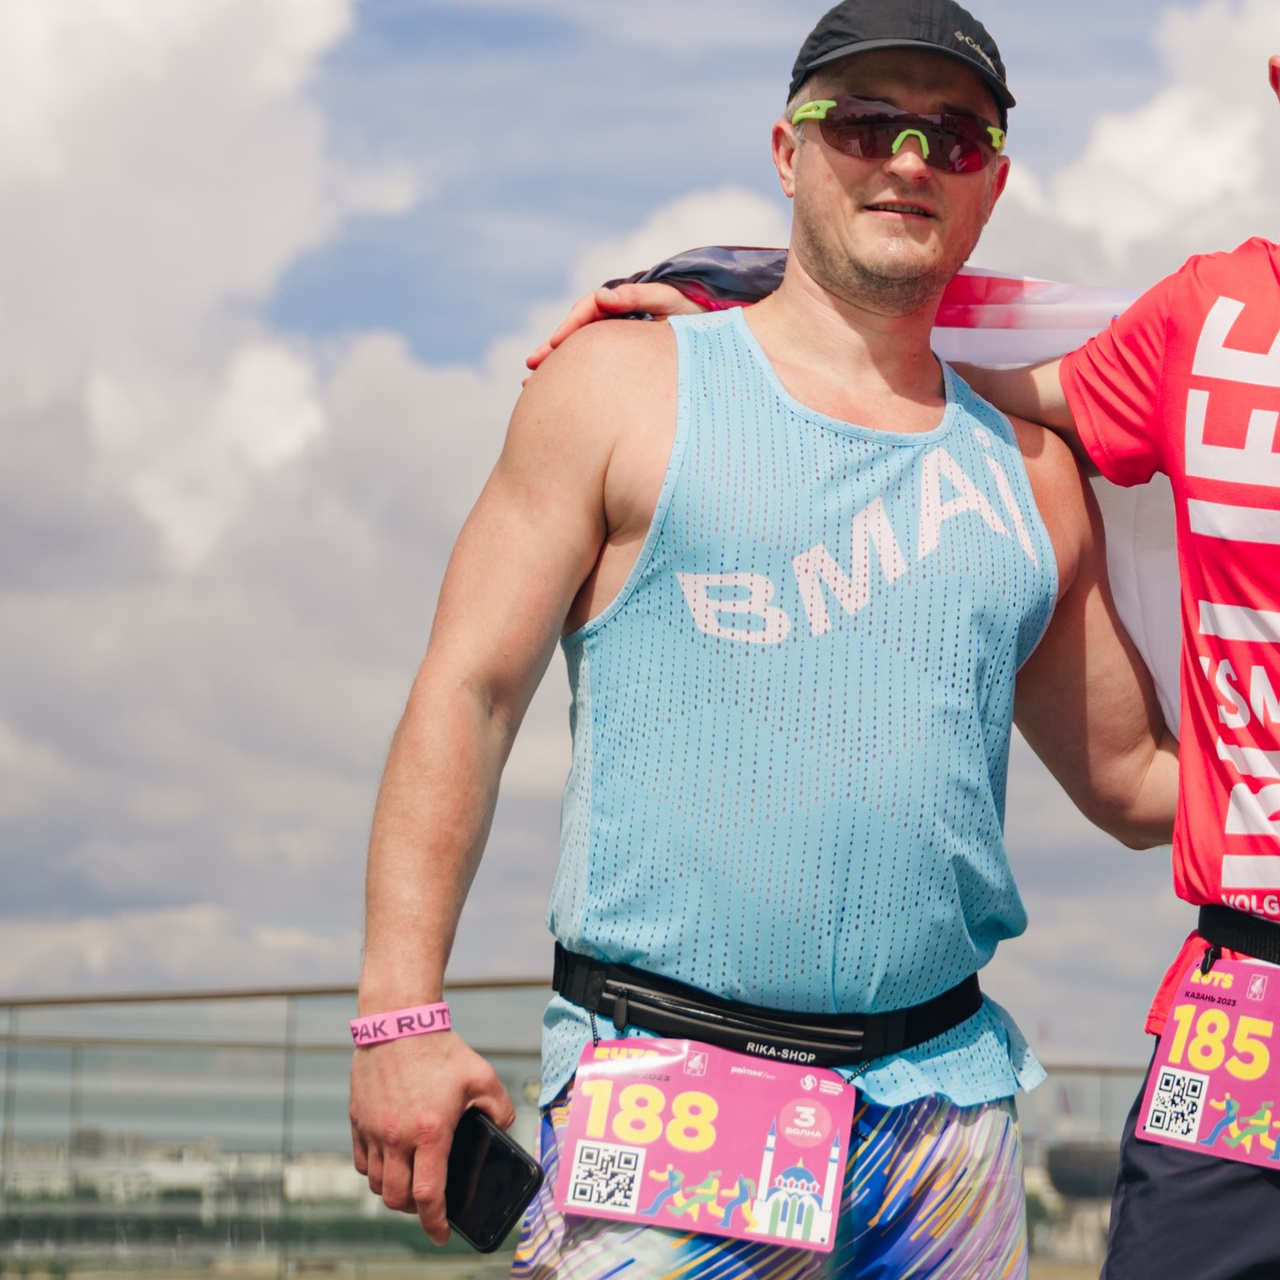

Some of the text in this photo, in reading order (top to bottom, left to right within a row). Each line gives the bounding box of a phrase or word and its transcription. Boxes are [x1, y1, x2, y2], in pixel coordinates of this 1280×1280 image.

[1190, 969, 1234, 989] RUTS
[1184, 990, 1237, 1007] КАЗАНЬ 2023
[396, 1008, 451, 1033] RUT
[746, 1041, 816, 1063] RIKA-SHOP
[1167, 1004, 1274, 1081] 185
[581, 1079, 719, 1153] 188
[793, 1106, 817, 1127] 3
[785, 1126, 822, 1139] ВОЛНА
